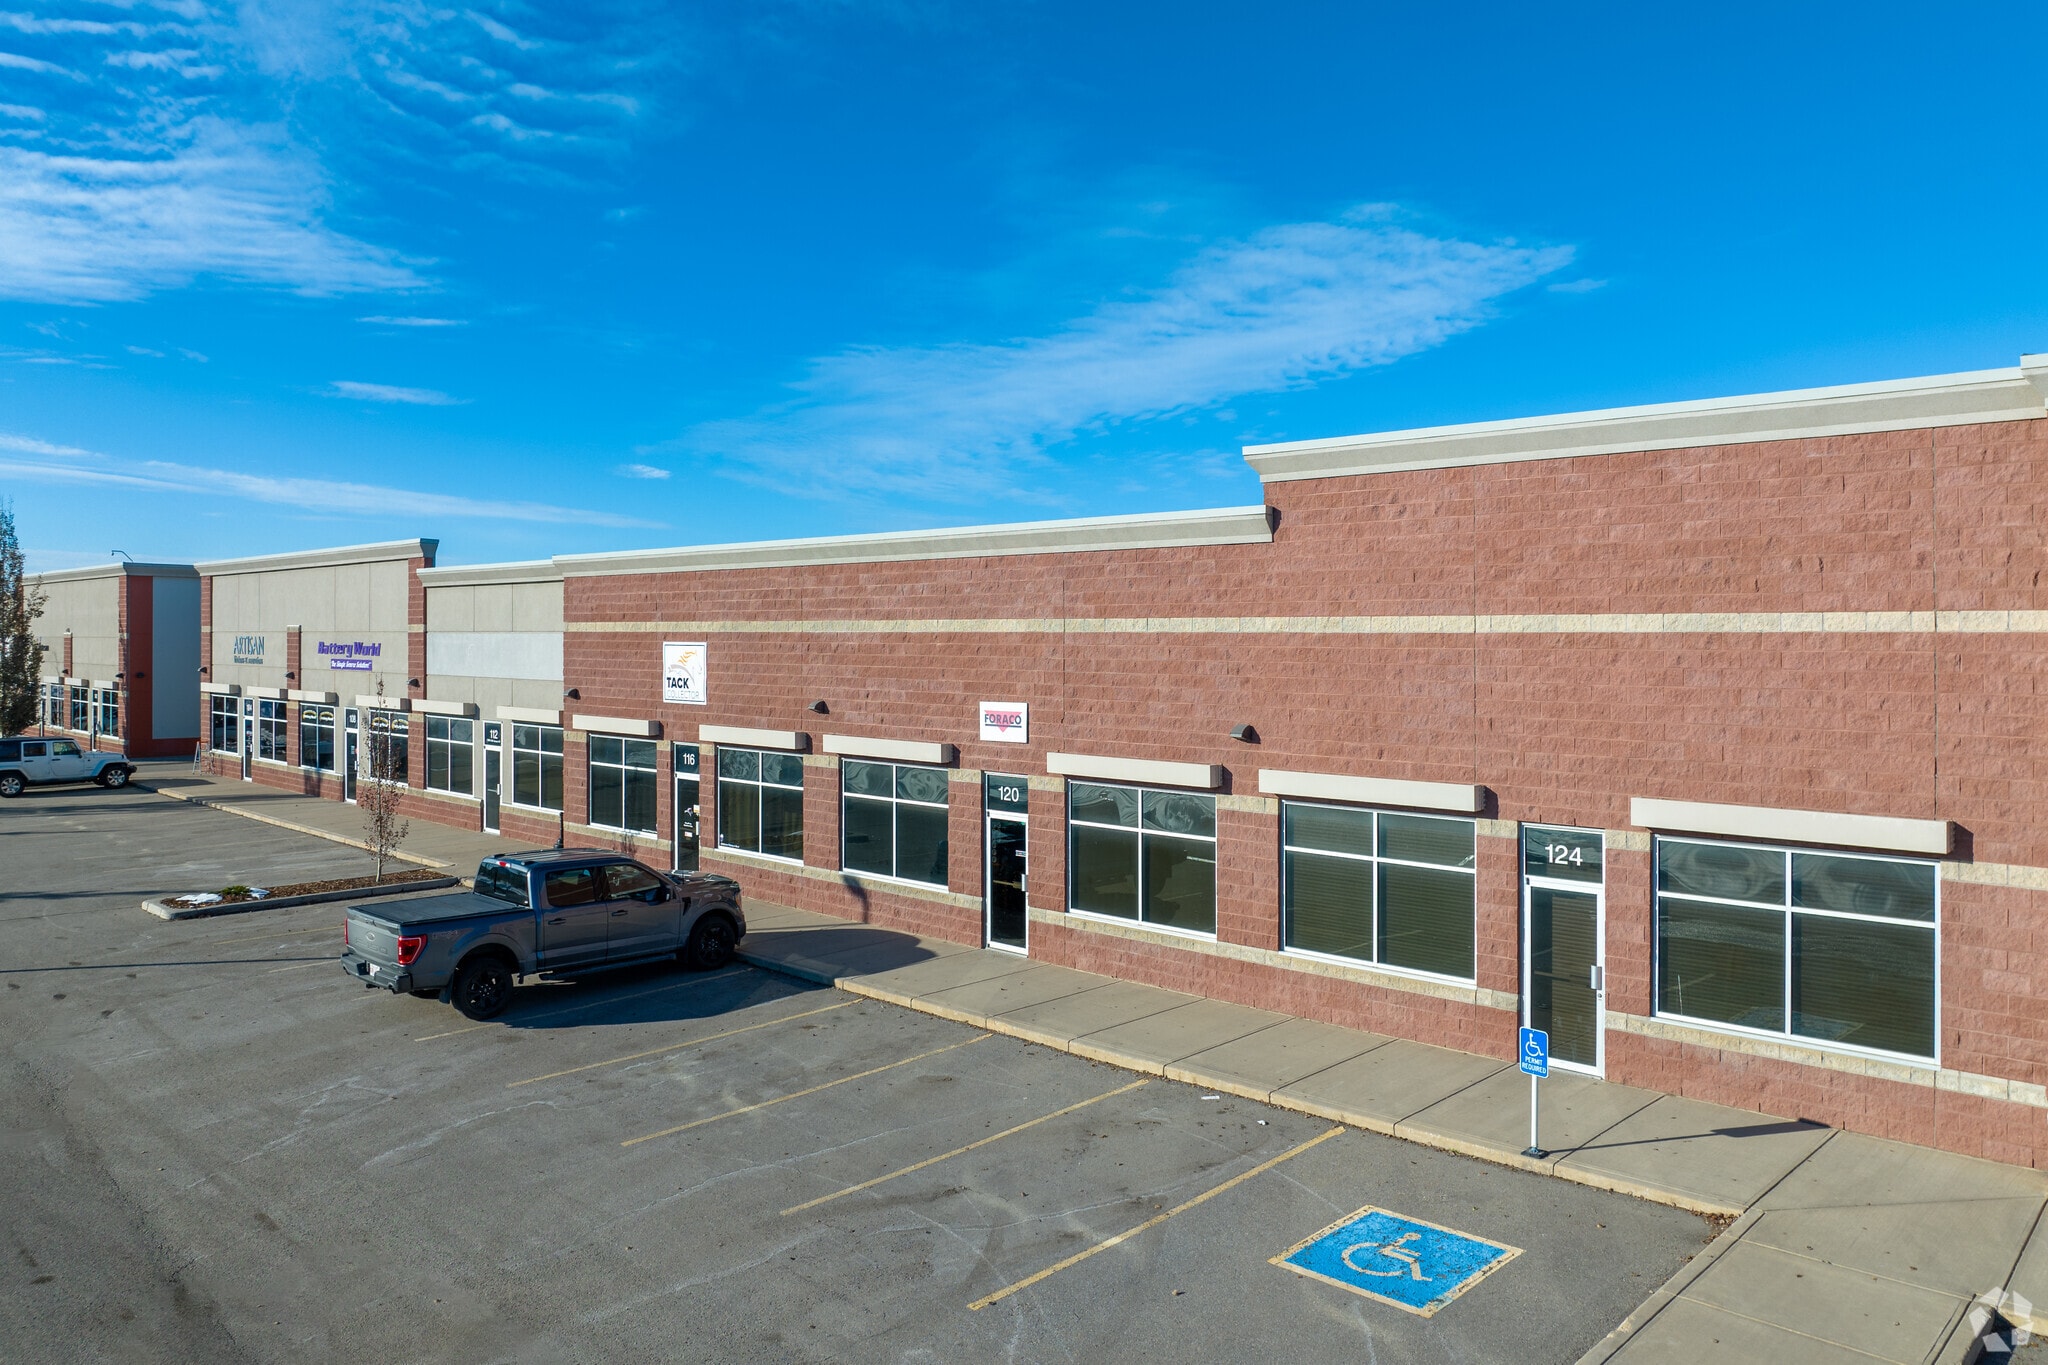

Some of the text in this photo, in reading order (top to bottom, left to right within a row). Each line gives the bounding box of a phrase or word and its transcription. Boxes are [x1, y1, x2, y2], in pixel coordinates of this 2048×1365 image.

[234, 636, 264, 656] ARTISAN
[317, 641, 381, 658] Battery World
[666, 677, 689, 689] TACK
[984, 713, 1022, 725] FORACO
[489, 729, 498, 739] 112
[683, 753, 695, 765] 116
[998, 786, 1019, 803] 120
[1544, 844, 1583, 866] 124
[1525, 1056, 1543, 1066] PERMIT
[1522, 1062, 1546, 1074] REQUIRED
